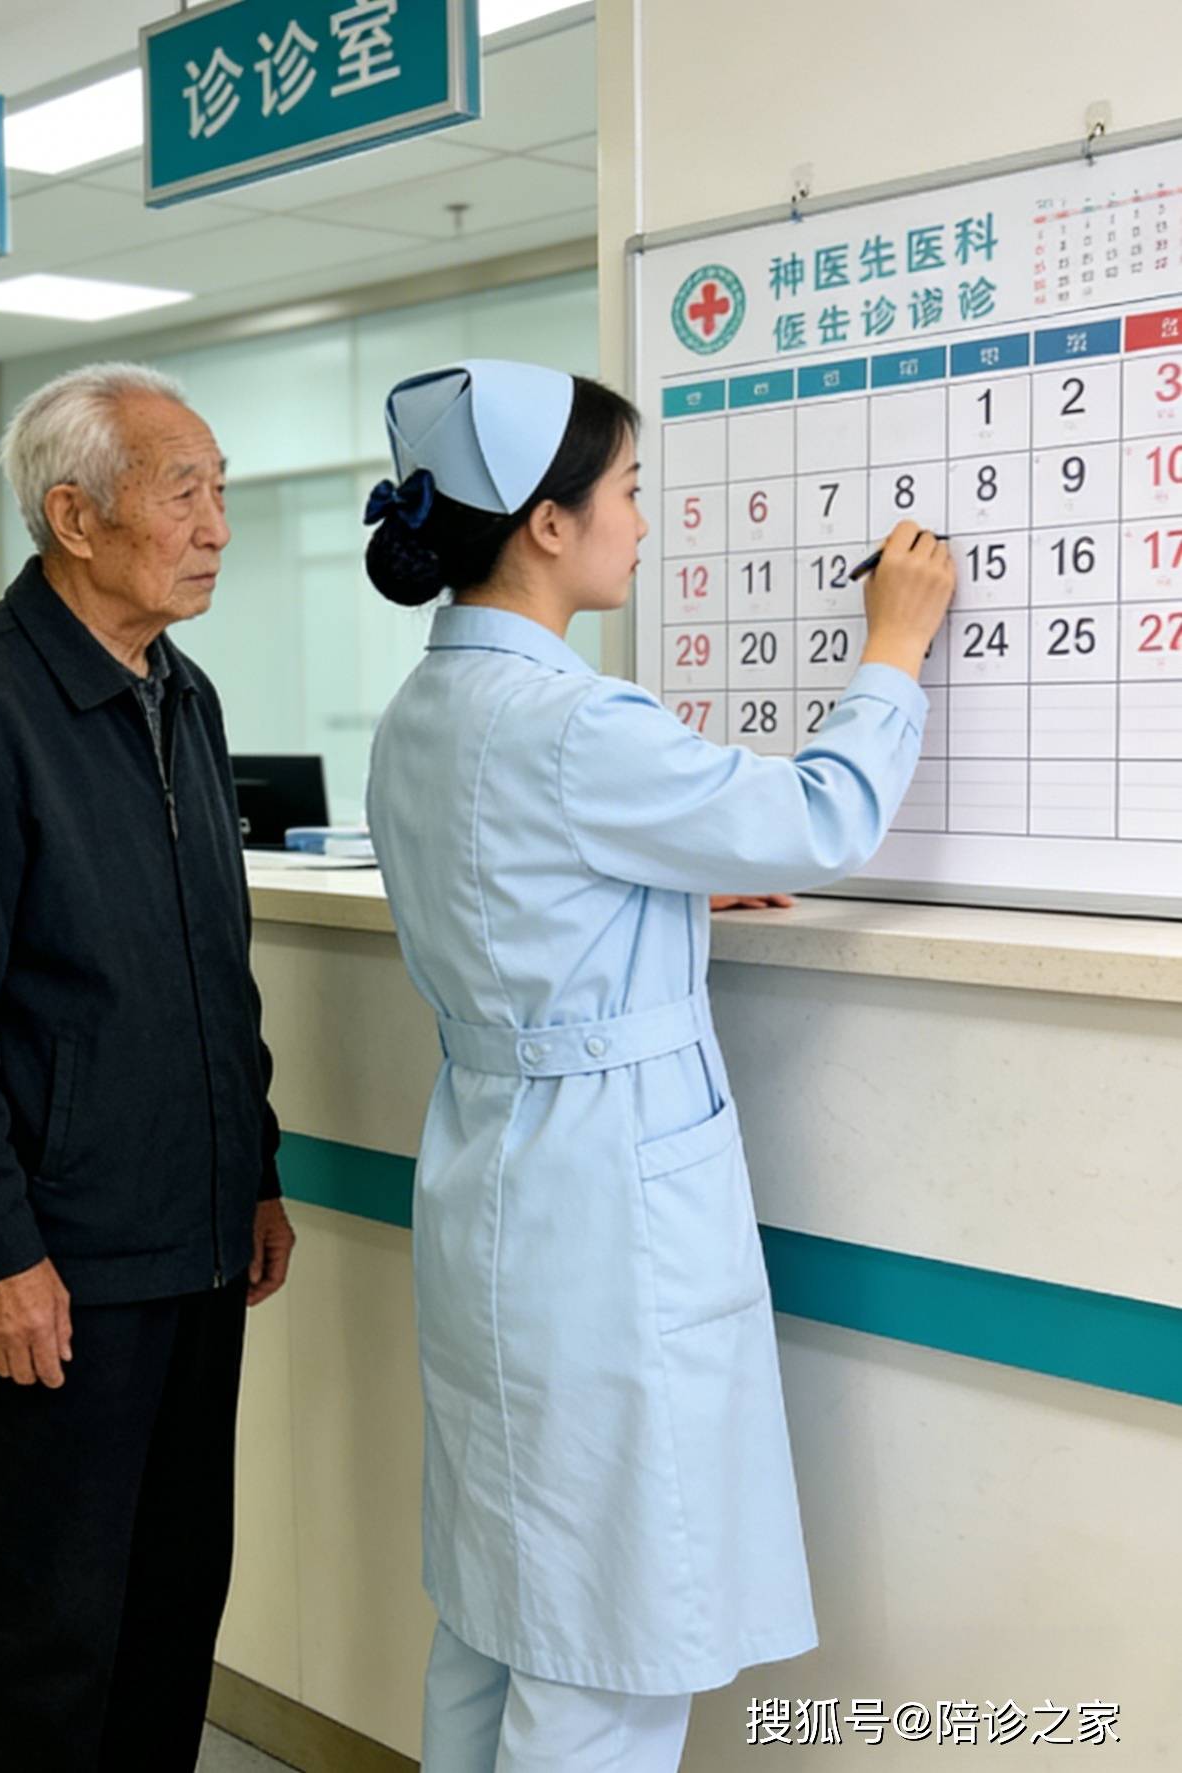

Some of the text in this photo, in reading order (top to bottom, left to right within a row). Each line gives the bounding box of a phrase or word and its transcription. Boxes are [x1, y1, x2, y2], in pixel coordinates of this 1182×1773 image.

[182, 0, 401, 140] 诊诊室
[977, 362, 1182, 426] 1 2 3
[683, 497, 702, 529] 5
[748, 490, 768, 524] 6
[819, 482, 840, 518] 7
[894, 473, 915, 510] 8
[976, 464, 998, 502] 8
[1061, 455, 1086, 494] 9
[678, 529, 1182, 599] 12 11 12 15 16 17
[676, 634, 711, 667] 29
[740, 631, 778, 666] 20
[962, 621, 1009, 659] 24
[1046, 617, 1096, 656] 25
[1137, 611, 1182, 653] 27
[739, 700, 778, 734] 28
[806, 700, 836, 734] 2
